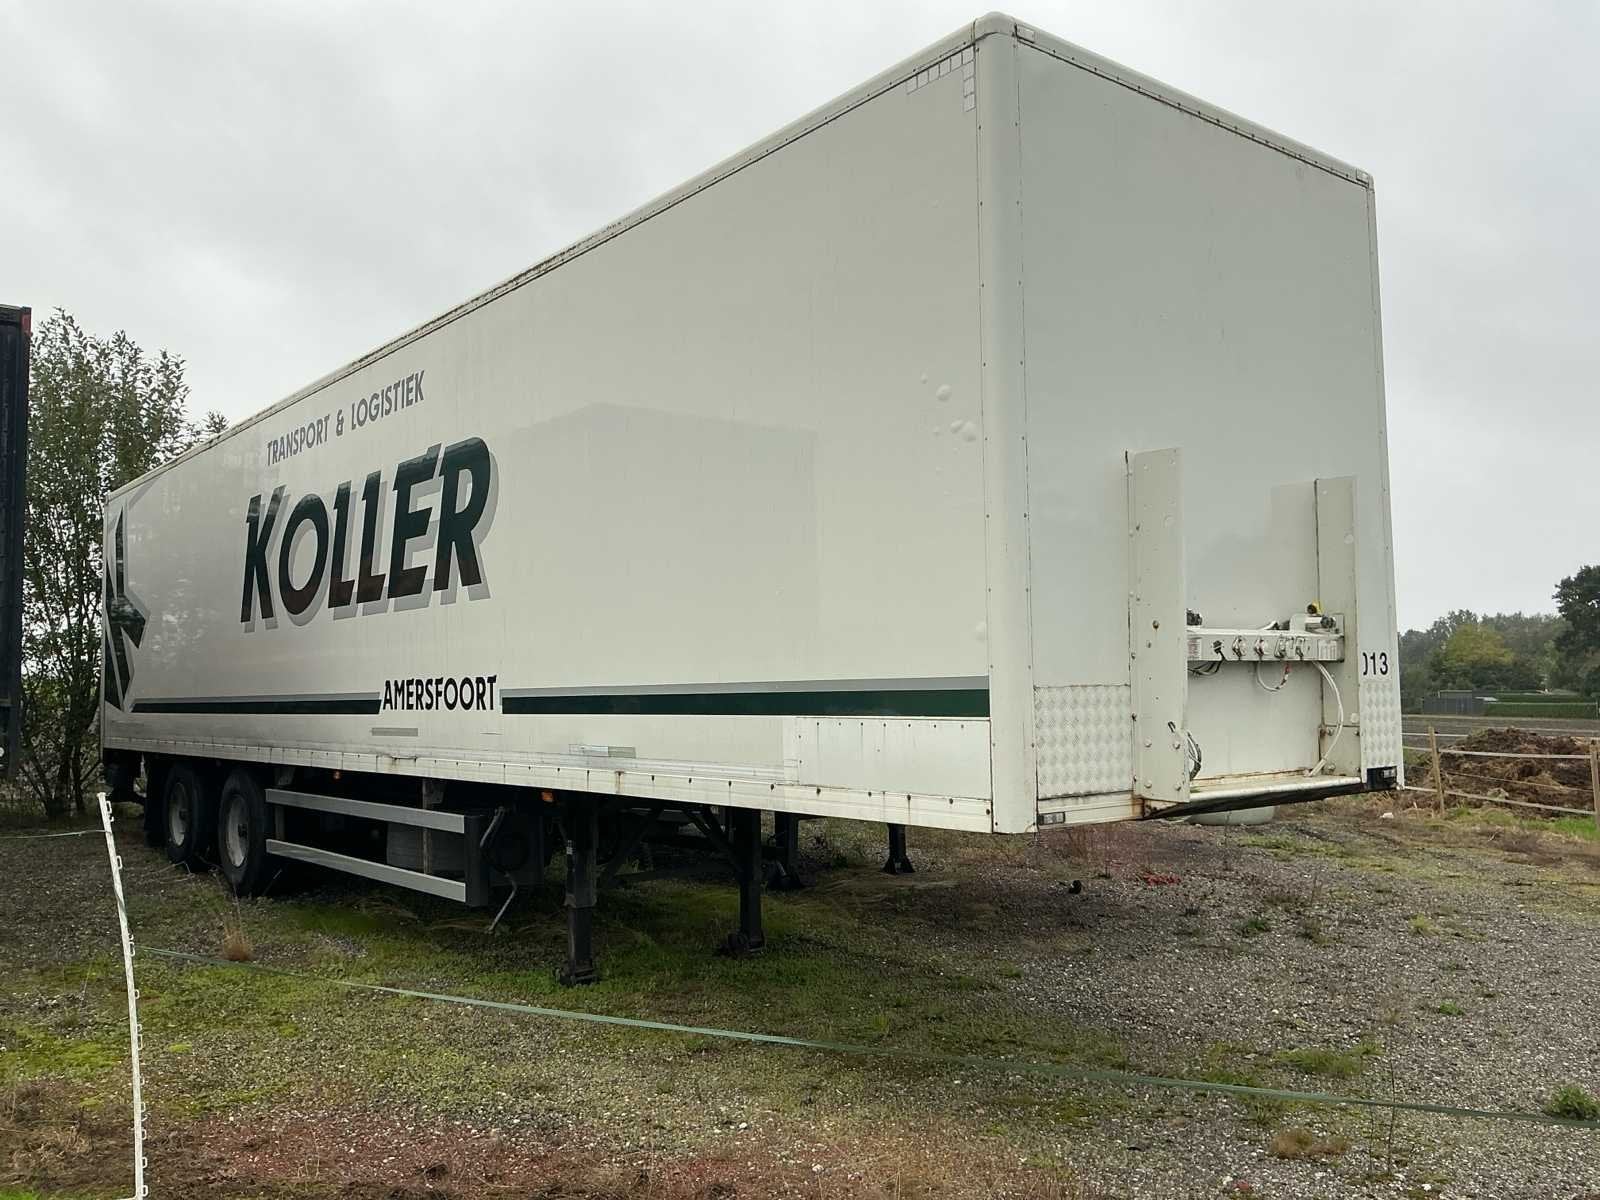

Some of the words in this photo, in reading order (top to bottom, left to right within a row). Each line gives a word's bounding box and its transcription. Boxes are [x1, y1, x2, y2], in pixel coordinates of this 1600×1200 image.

[267, 413, 330, 466] TRANSPORT
[336, 409, 345, 436] &
[351, 370, 425, 430] LOGISTIEK
[241, 437, 494, 626] KOLLER
[382, 675, 497, 711] AMERSFOORT
